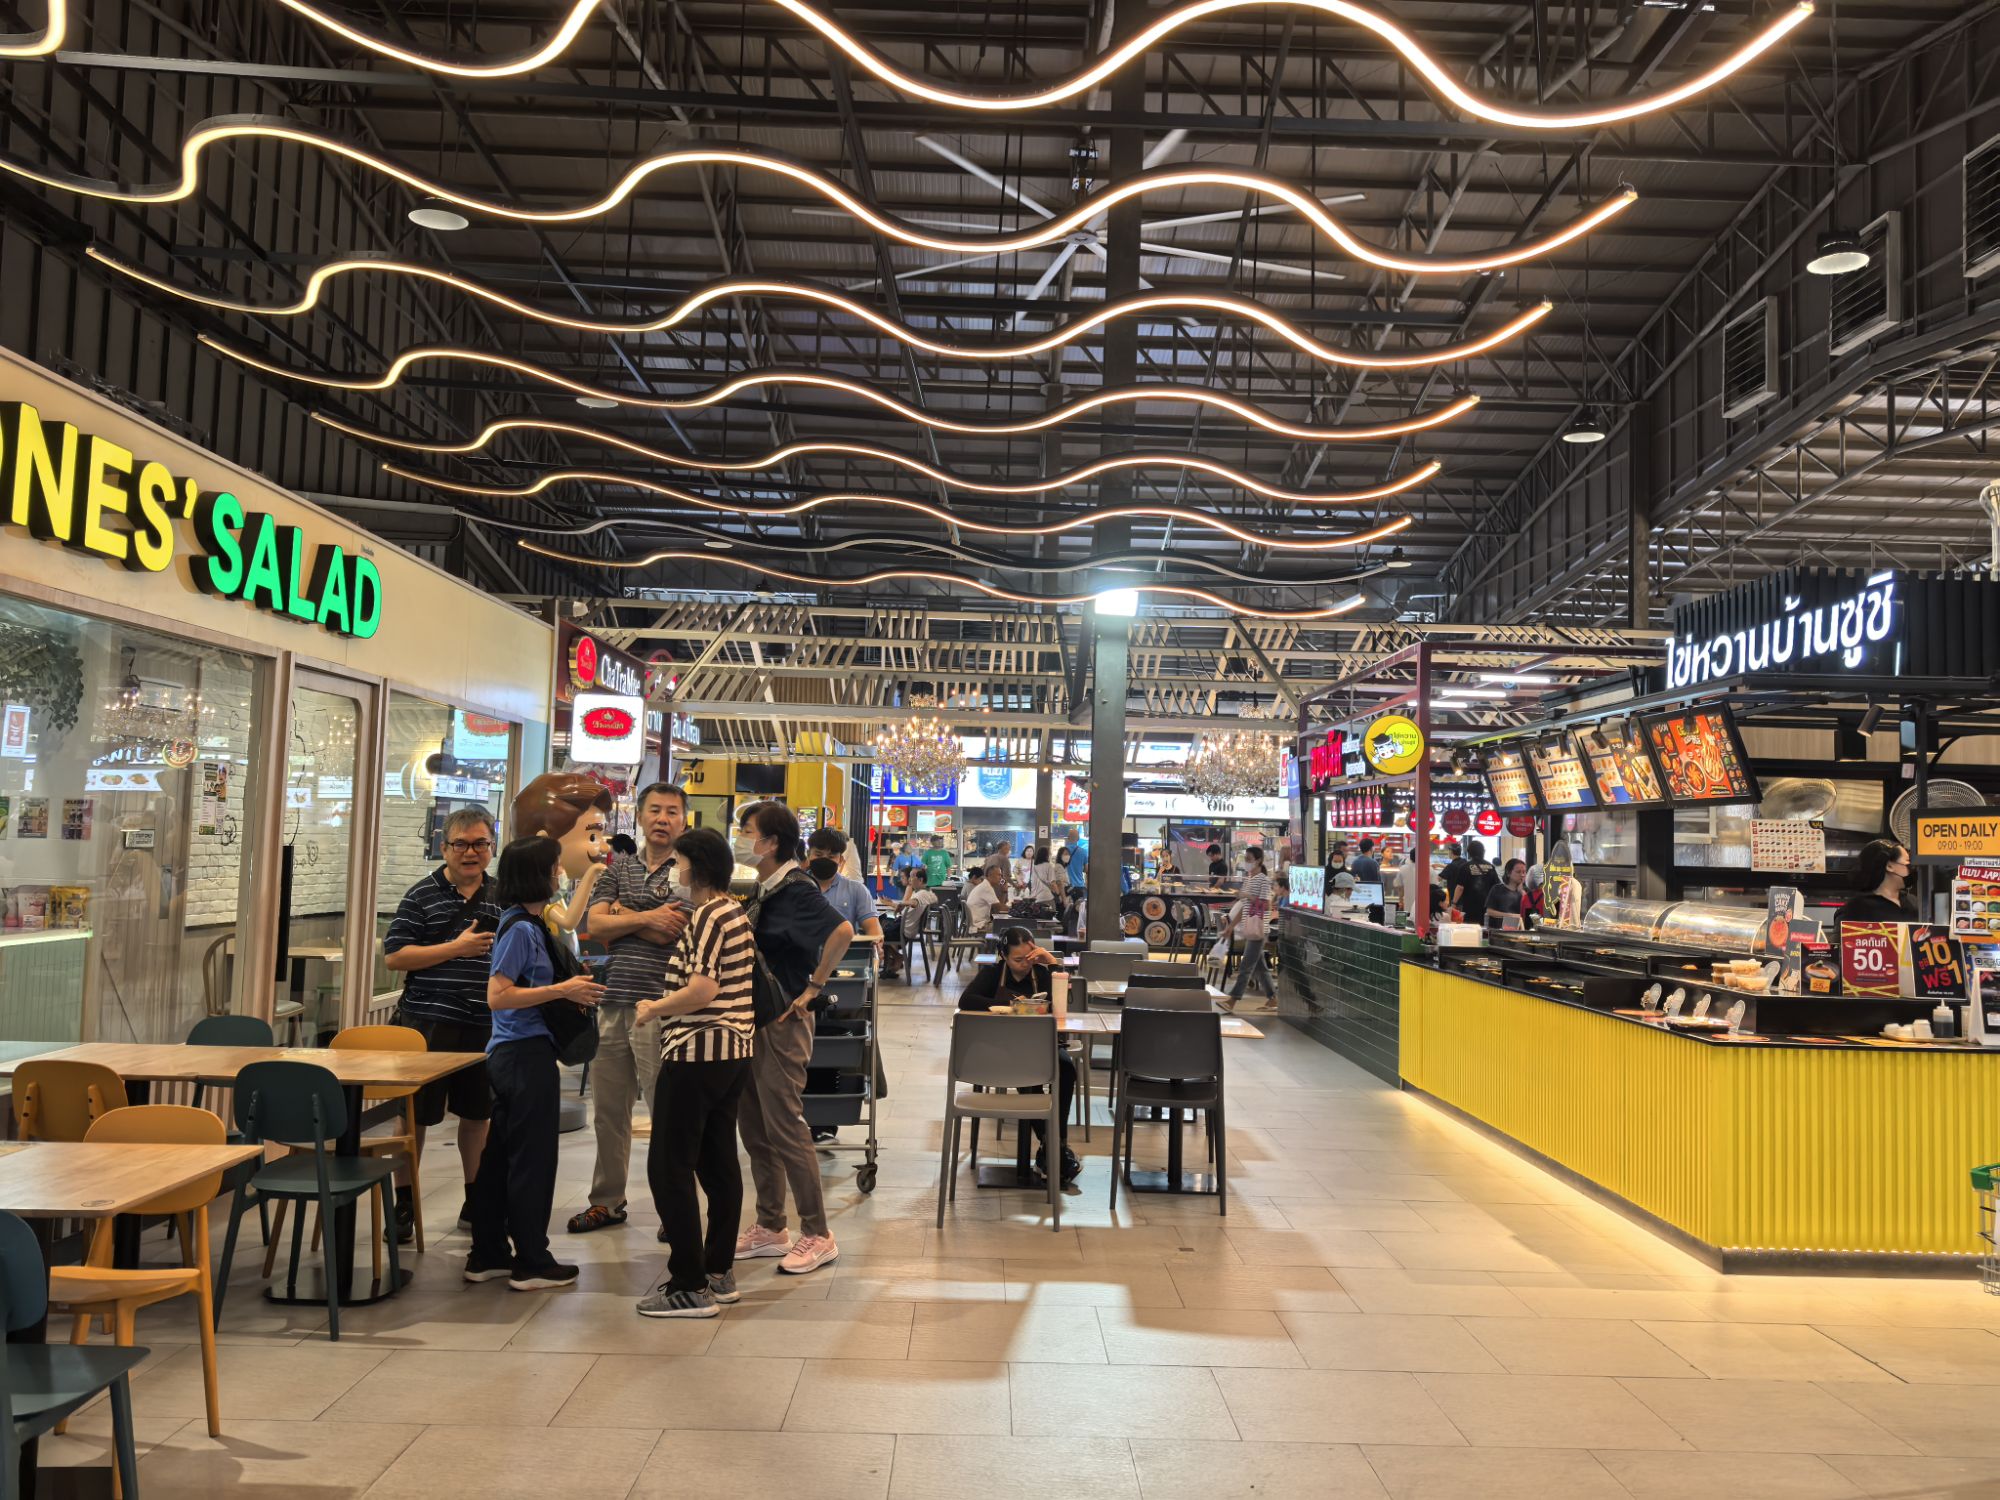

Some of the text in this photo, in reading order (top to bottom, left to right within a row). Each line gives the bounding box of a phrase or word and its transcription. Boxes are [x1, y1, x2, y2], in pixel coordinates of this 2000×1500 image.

[0, 402, 382, 639] NES' SALAD
[1664, 570, 1894, 690] ไข่หวานบ้านซูชิ
[601, 654, 641, 696] ChaTraMue
[1923, 822, 1998, 838] OPEN DAILY
[1981, 870, 2000, 882] JAP
[1853, 948, 1894, 972] 50.-
[1919, 941, 1952, 966] 10
